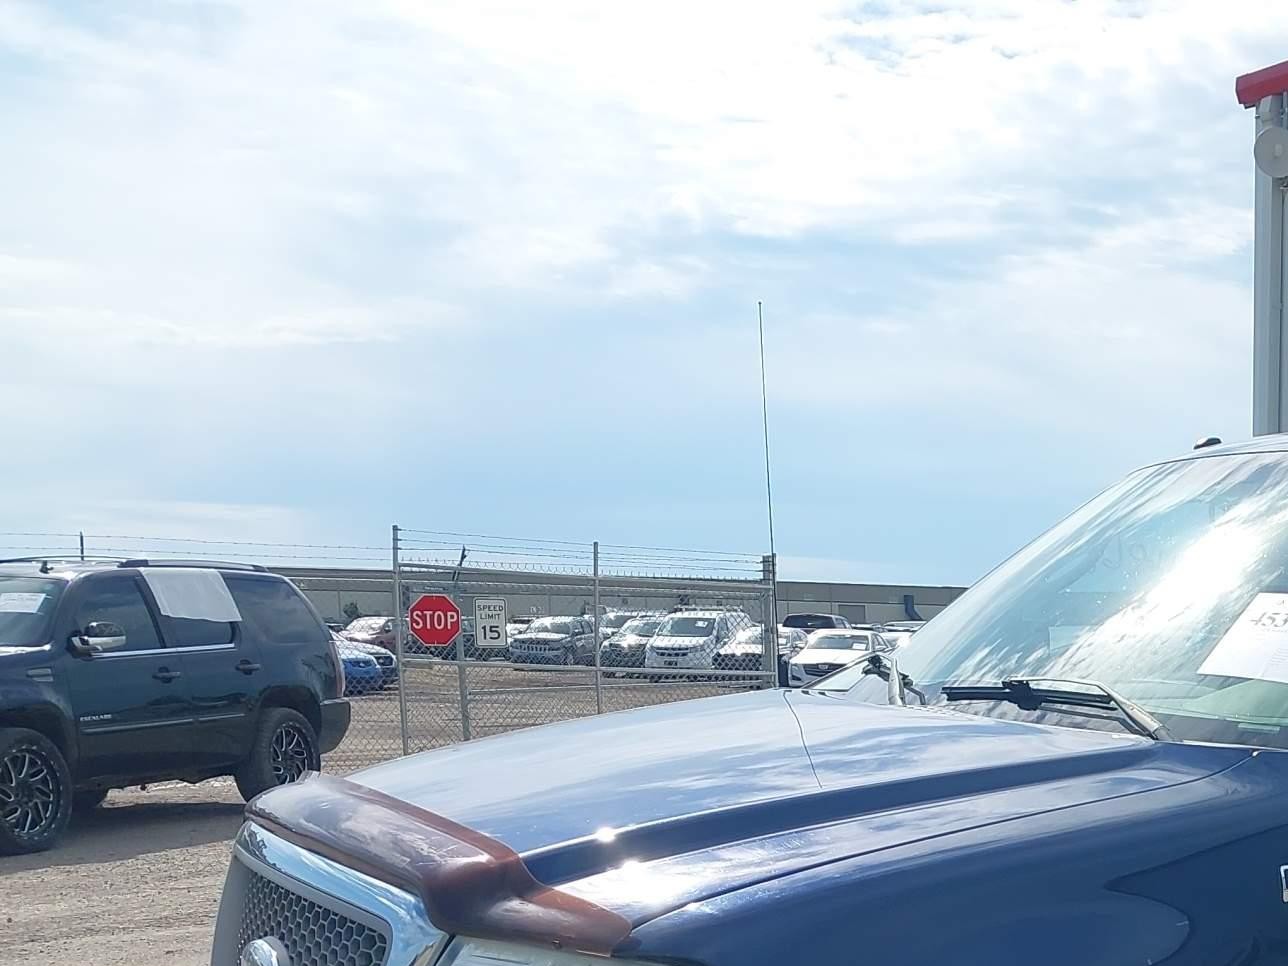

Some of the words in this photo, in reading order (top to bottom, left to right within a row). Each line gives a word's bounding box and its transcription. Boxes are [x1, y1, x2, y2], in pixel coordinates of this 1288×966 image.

[477, 604, 504, 612] SPEED
[412, 610, 457, 630] STOP
[481, 625, 501, 640] 15
